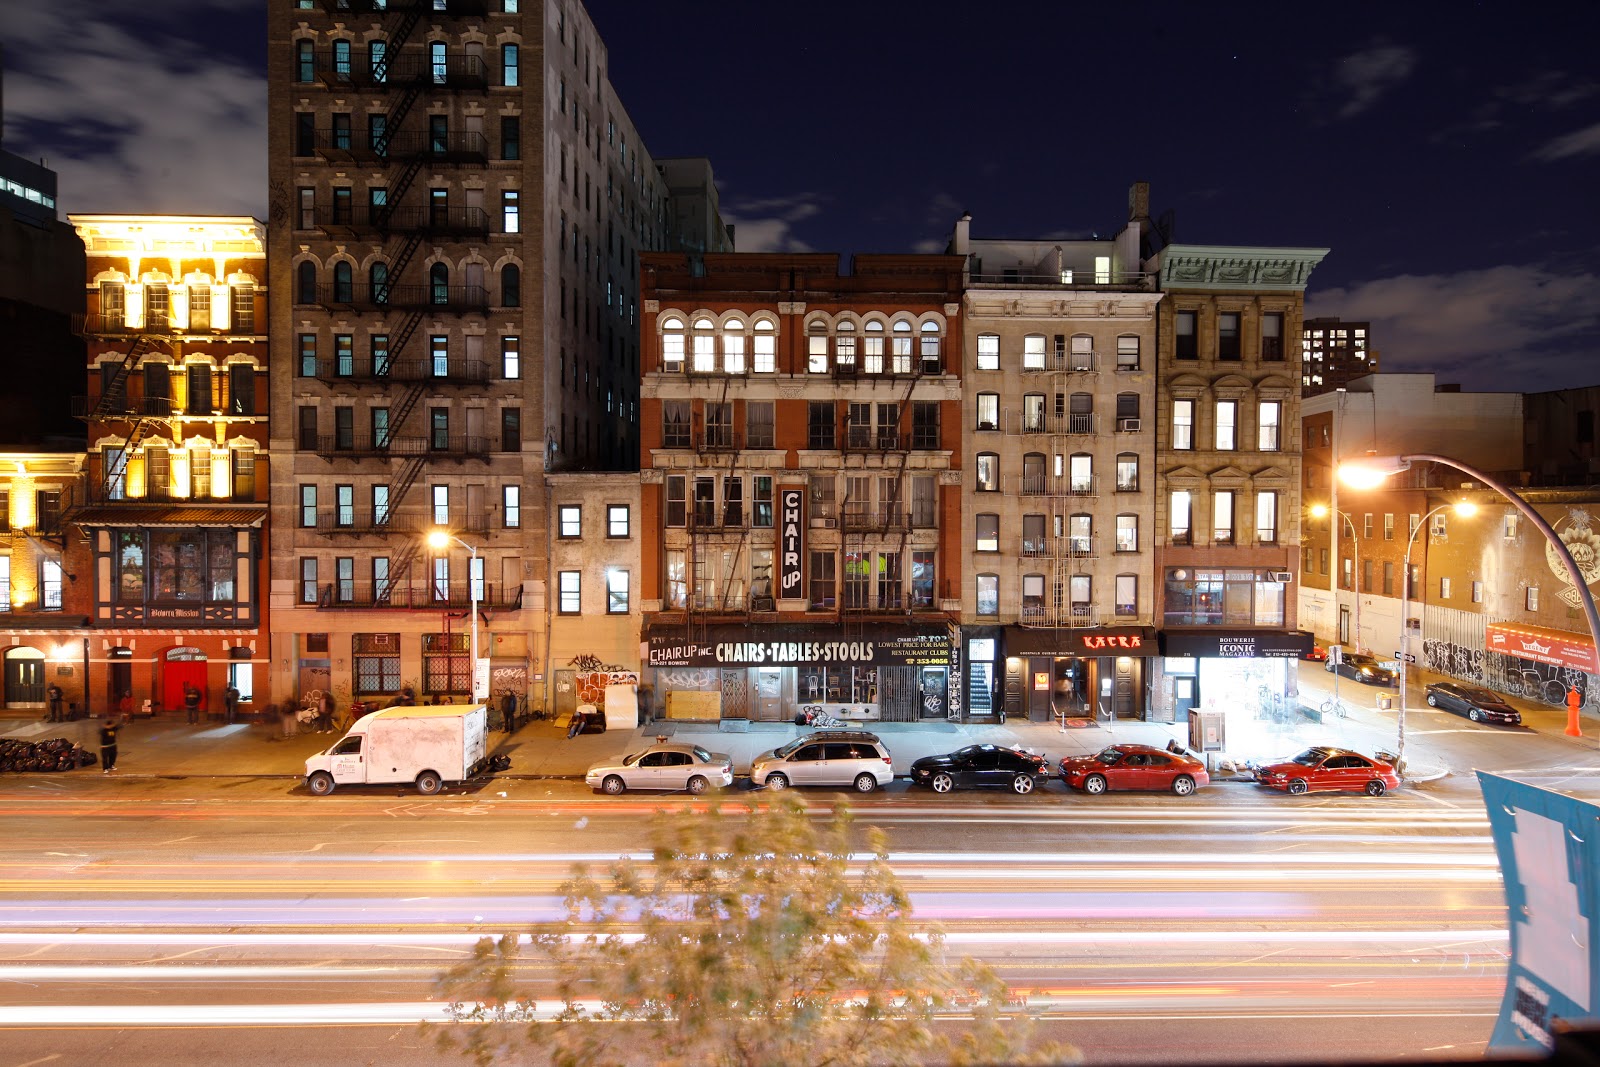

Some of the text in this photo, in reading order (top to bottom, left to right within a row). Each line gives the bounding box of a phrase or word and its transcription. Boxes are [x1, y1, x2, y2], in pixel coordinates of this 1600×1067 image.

[785, 493, 799, 566] CHAIR
[783, 571, 801, 589] UP
[151, 609, 200, 618] Bowery Mission
[1083, 636, 1141, 648] KATRA
[1219, 644, 1255, 652] ICONIC
[1524, 644, 1548, 652] REGENT
[650, 645, 714, 662] CHAIR UP INC.
[716, 642, 874, 662] CHAIRS TABLES STOOLS
[1511, 649, 1537, 660] RESTAURANT
[1537, 655, 1564, 665] EQUIPMENT
